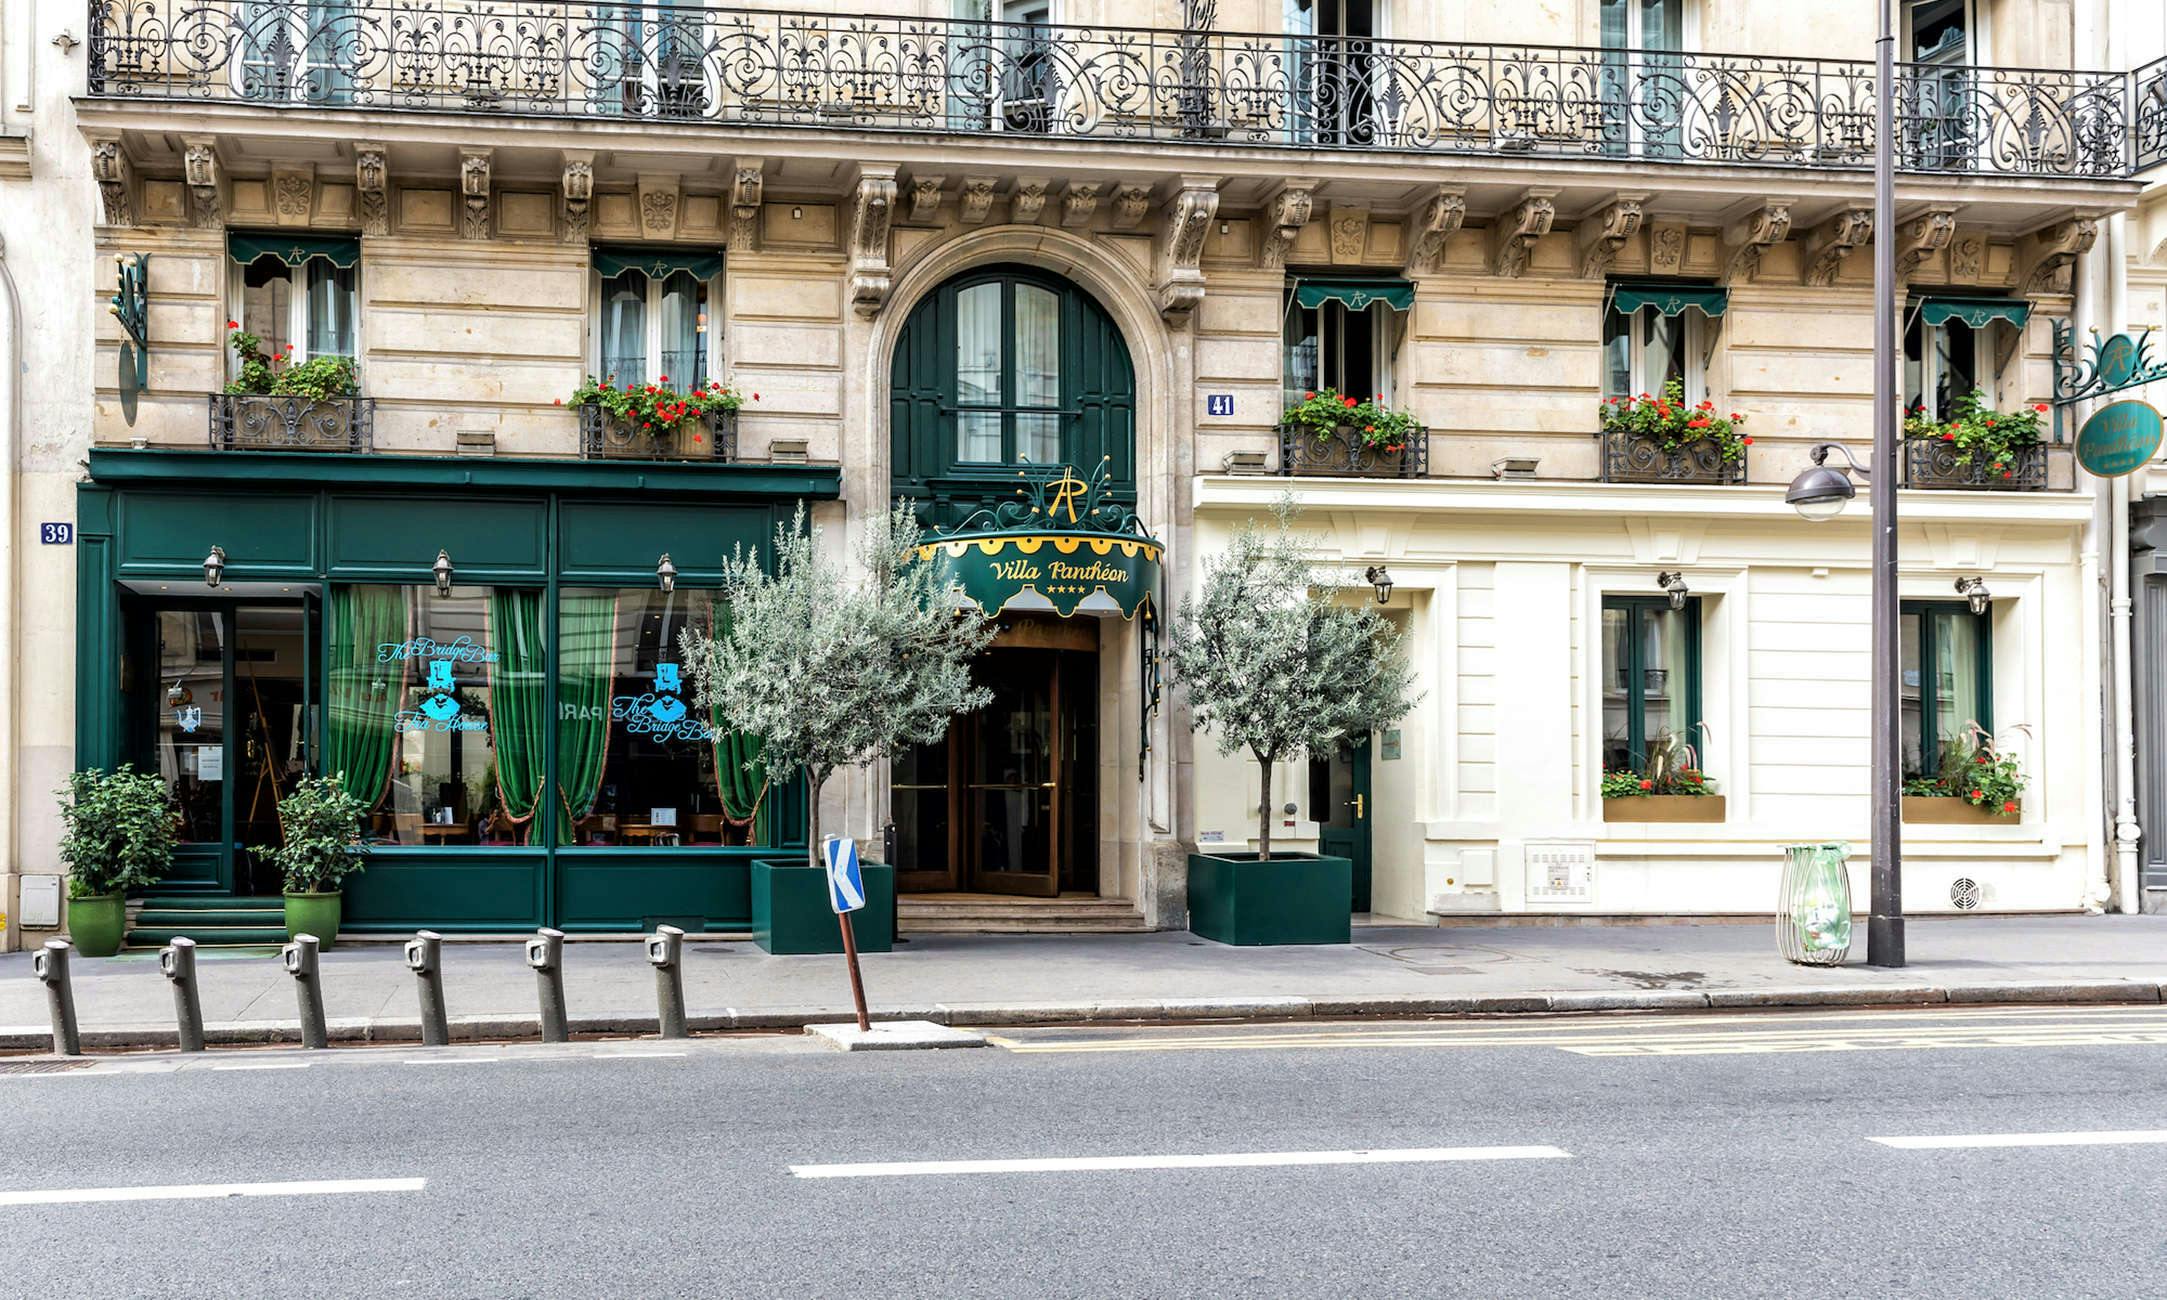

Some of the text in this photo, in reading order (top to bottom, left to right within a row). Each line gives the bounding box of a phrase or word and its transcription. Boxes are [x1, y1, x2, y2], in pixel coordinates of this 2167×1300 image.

[1212, 396, 1231, 415] 41
[45, 524, 69, 543] 39
[990, 559, 1129, 583] Villa Panthéon
[377, 635, 500, 663] The Bridge Bar
[613, 693, 655, 718] The
[394, 710, 489, 733] Tea House
[627, 715, 681, 743] Bridge
